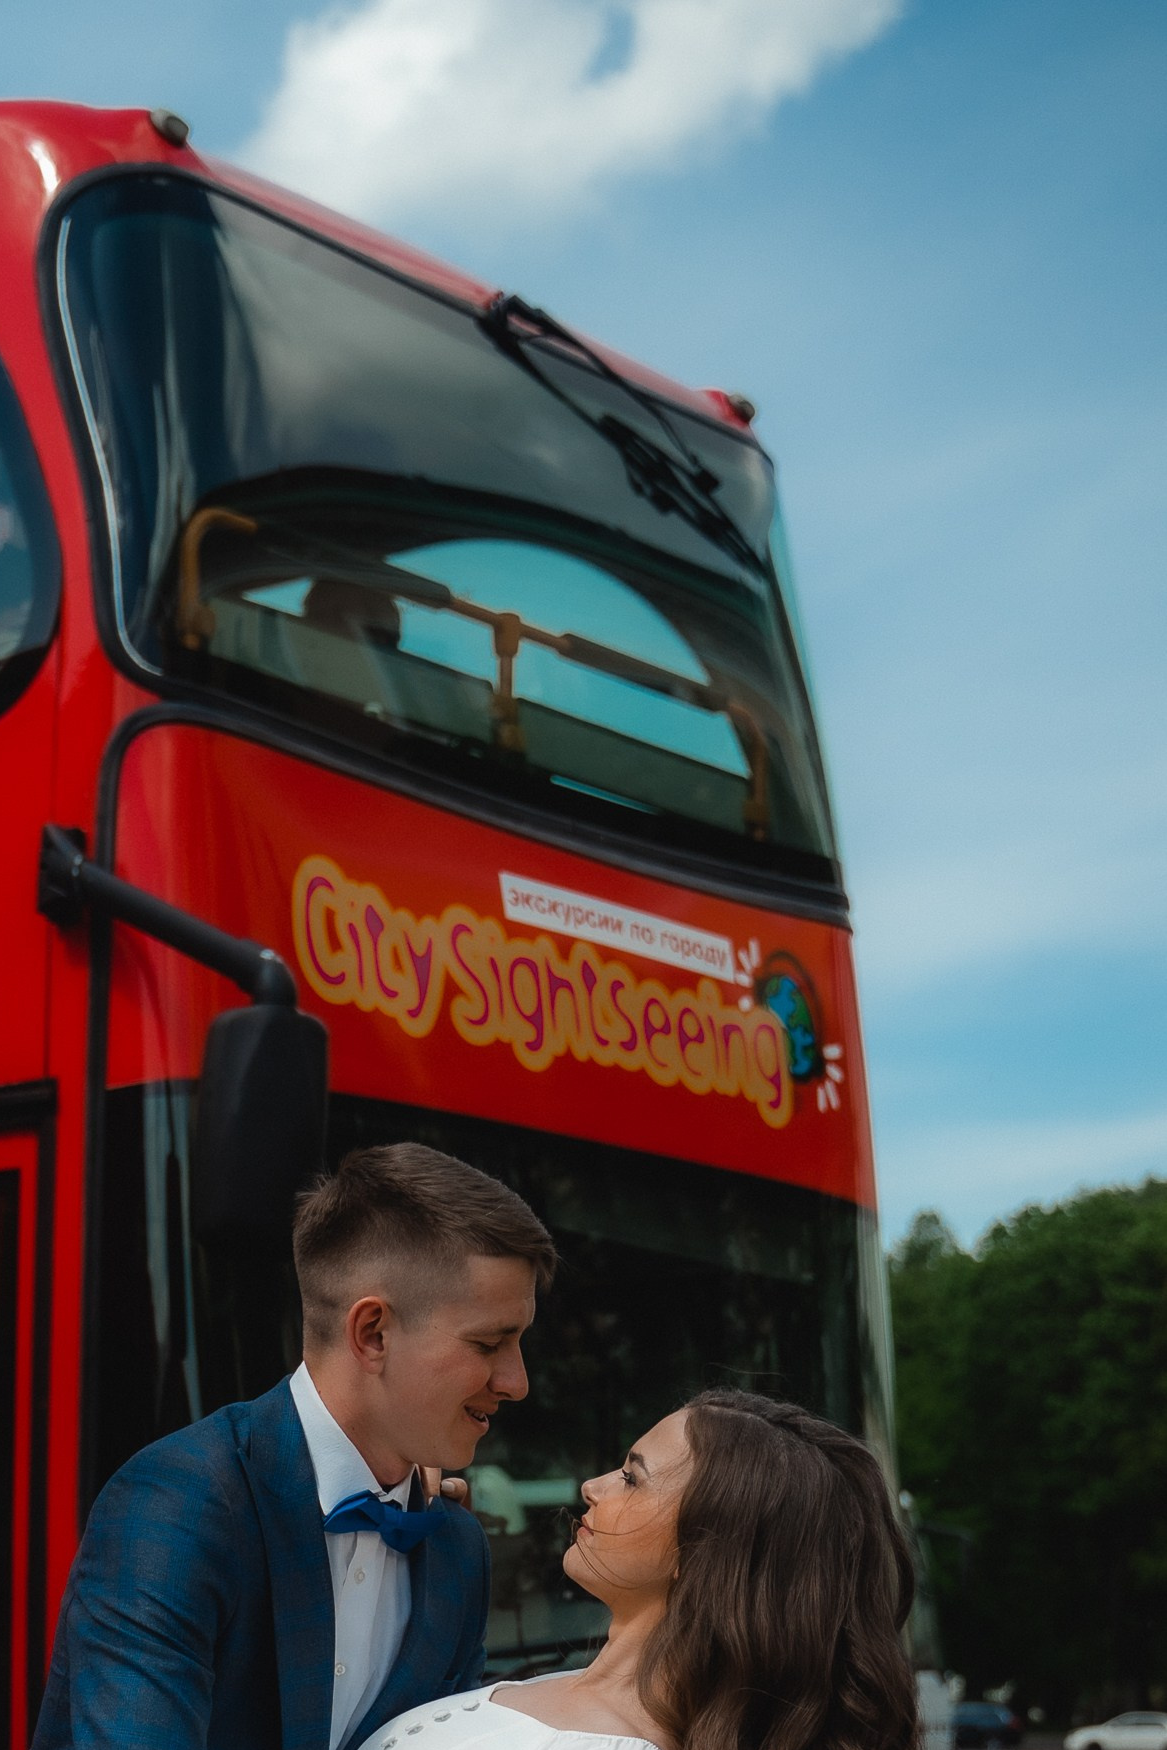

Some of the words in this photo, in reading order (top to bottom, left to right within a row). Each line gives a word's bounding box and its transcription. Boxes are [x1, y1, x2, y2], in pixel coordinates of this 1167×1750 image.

[507, 887, 625, 933] экскурсии
[629, 922, 657, 945] по
[660, 930, 728, 969] городу
